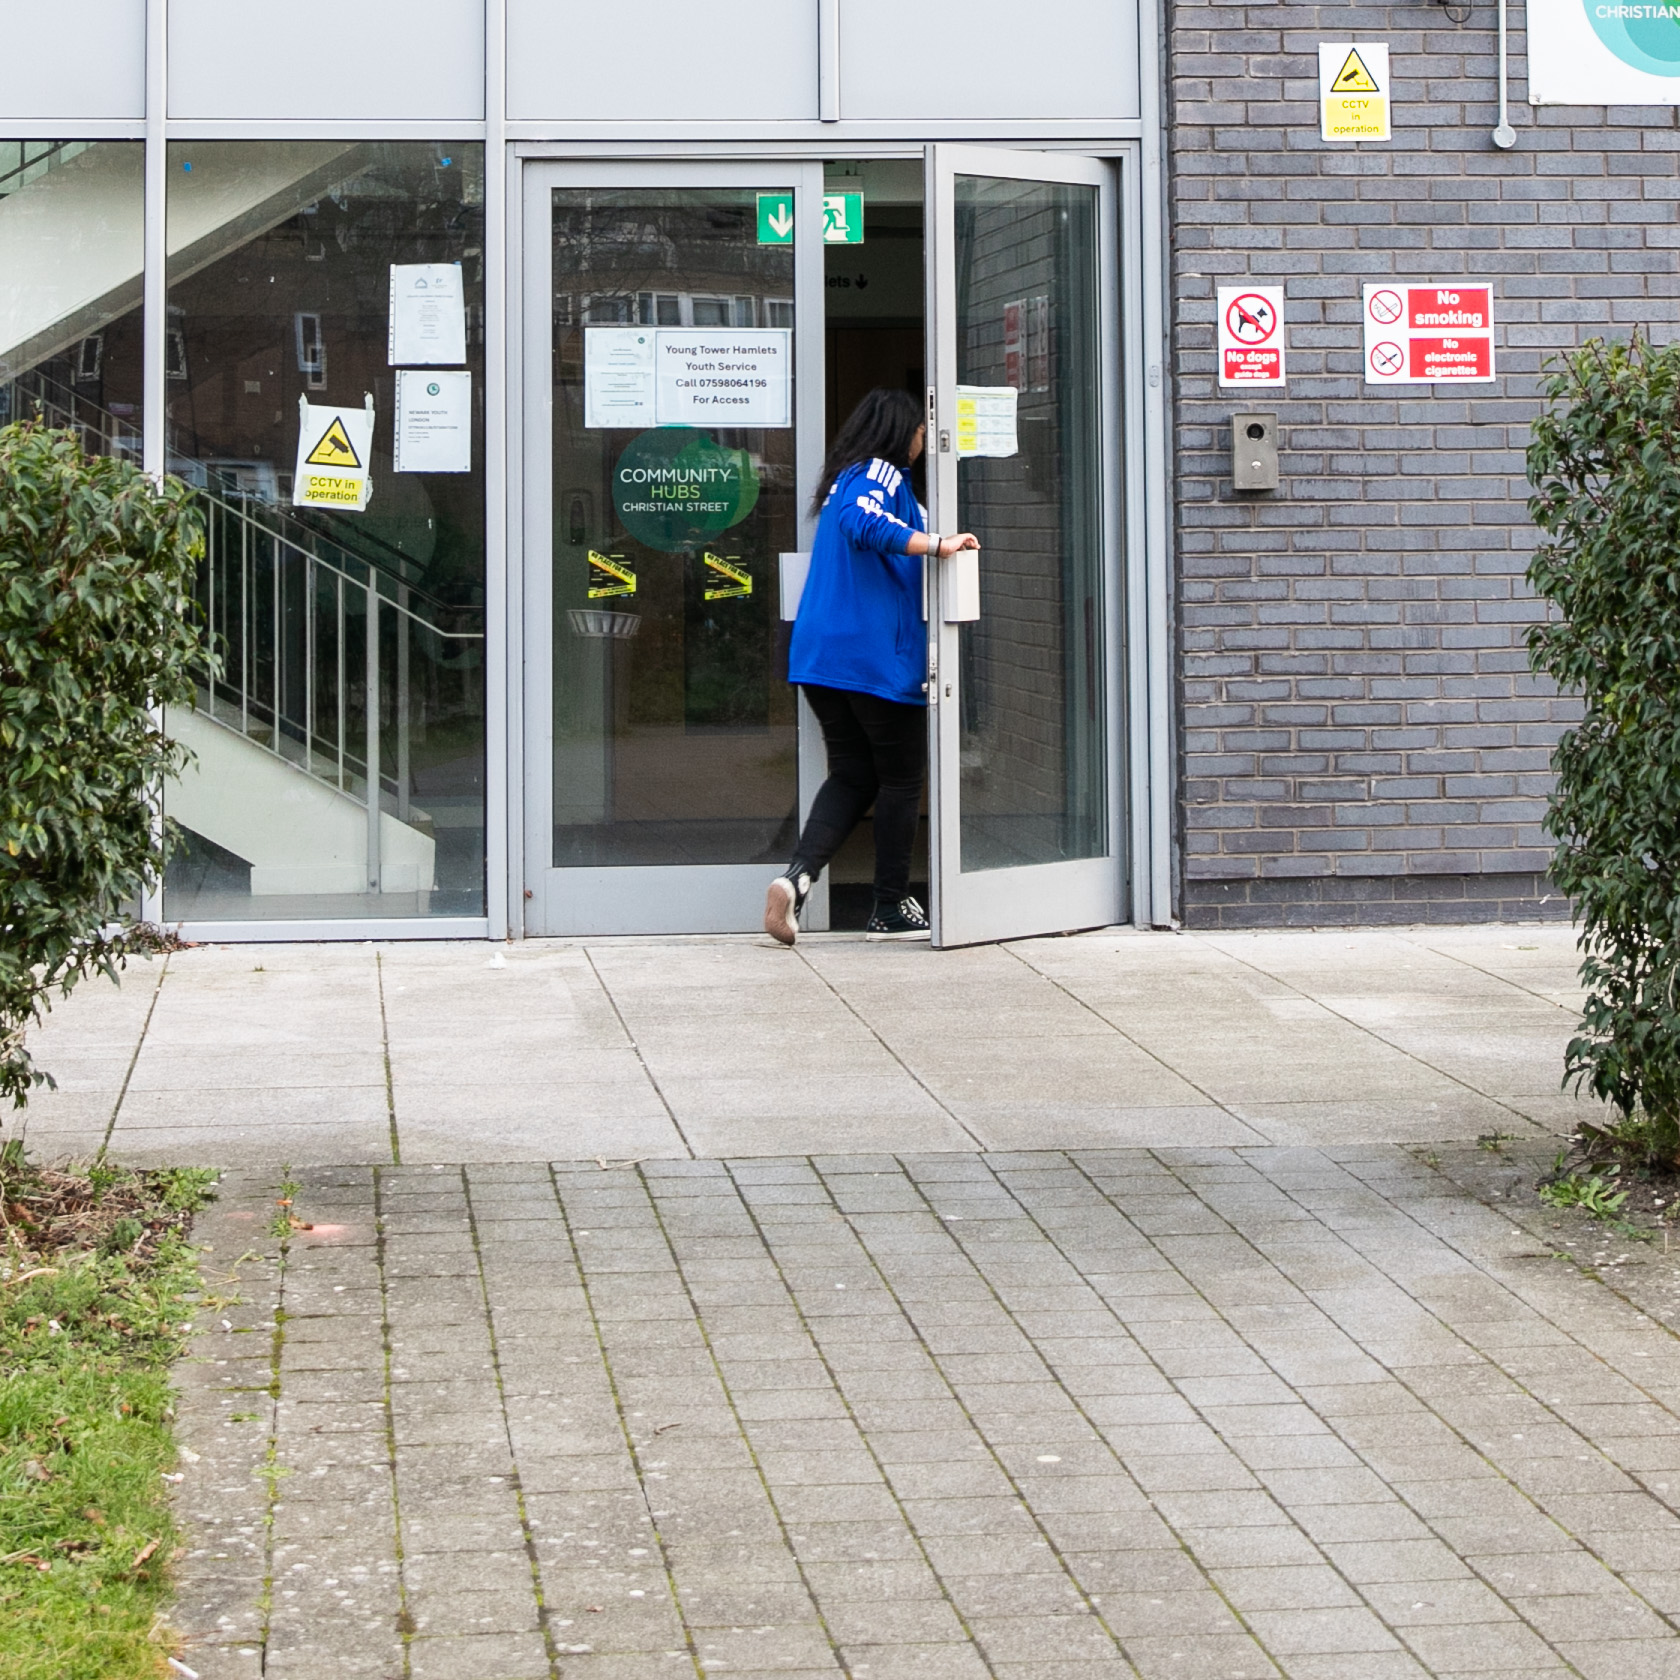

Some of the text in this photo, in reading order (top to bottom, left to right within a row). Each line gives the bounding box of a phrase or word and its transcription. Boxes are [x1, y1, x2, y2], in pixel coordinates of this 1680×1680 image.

[1595, 5, 1680, 20] CHRISTIAN
[1341, 100, 1369, 109] CCTV
[1351, 111, 1361, 120] in
[1333, 124, 1380, 135] operation
[1437, 290, 1460, 305] No
[1415, 309, 1483, 328] smoking
[1442, 338, 1459, 349] No
[665, 345, 777, 356] Young Tower Hamlets
[1226, 350, 1278, 365] No dogs
[1424, 351, 1478, 363] electronic
[685, 362, 757, 371] Youth Service
[1424, 365, 1478, 378] cigarettes
[676, 378, 768, 388] Call 07598064196
[693, 395, 751, 405] For Access
[620, 468, 732, 483] COMMUNITY
[309, 476, 356, 490] CCTV in
[305, 490, 358, 501] operation
[651, 485, 701, 499] HUBS
[622, 501, 730, 512] CHRISTIAN STREET
